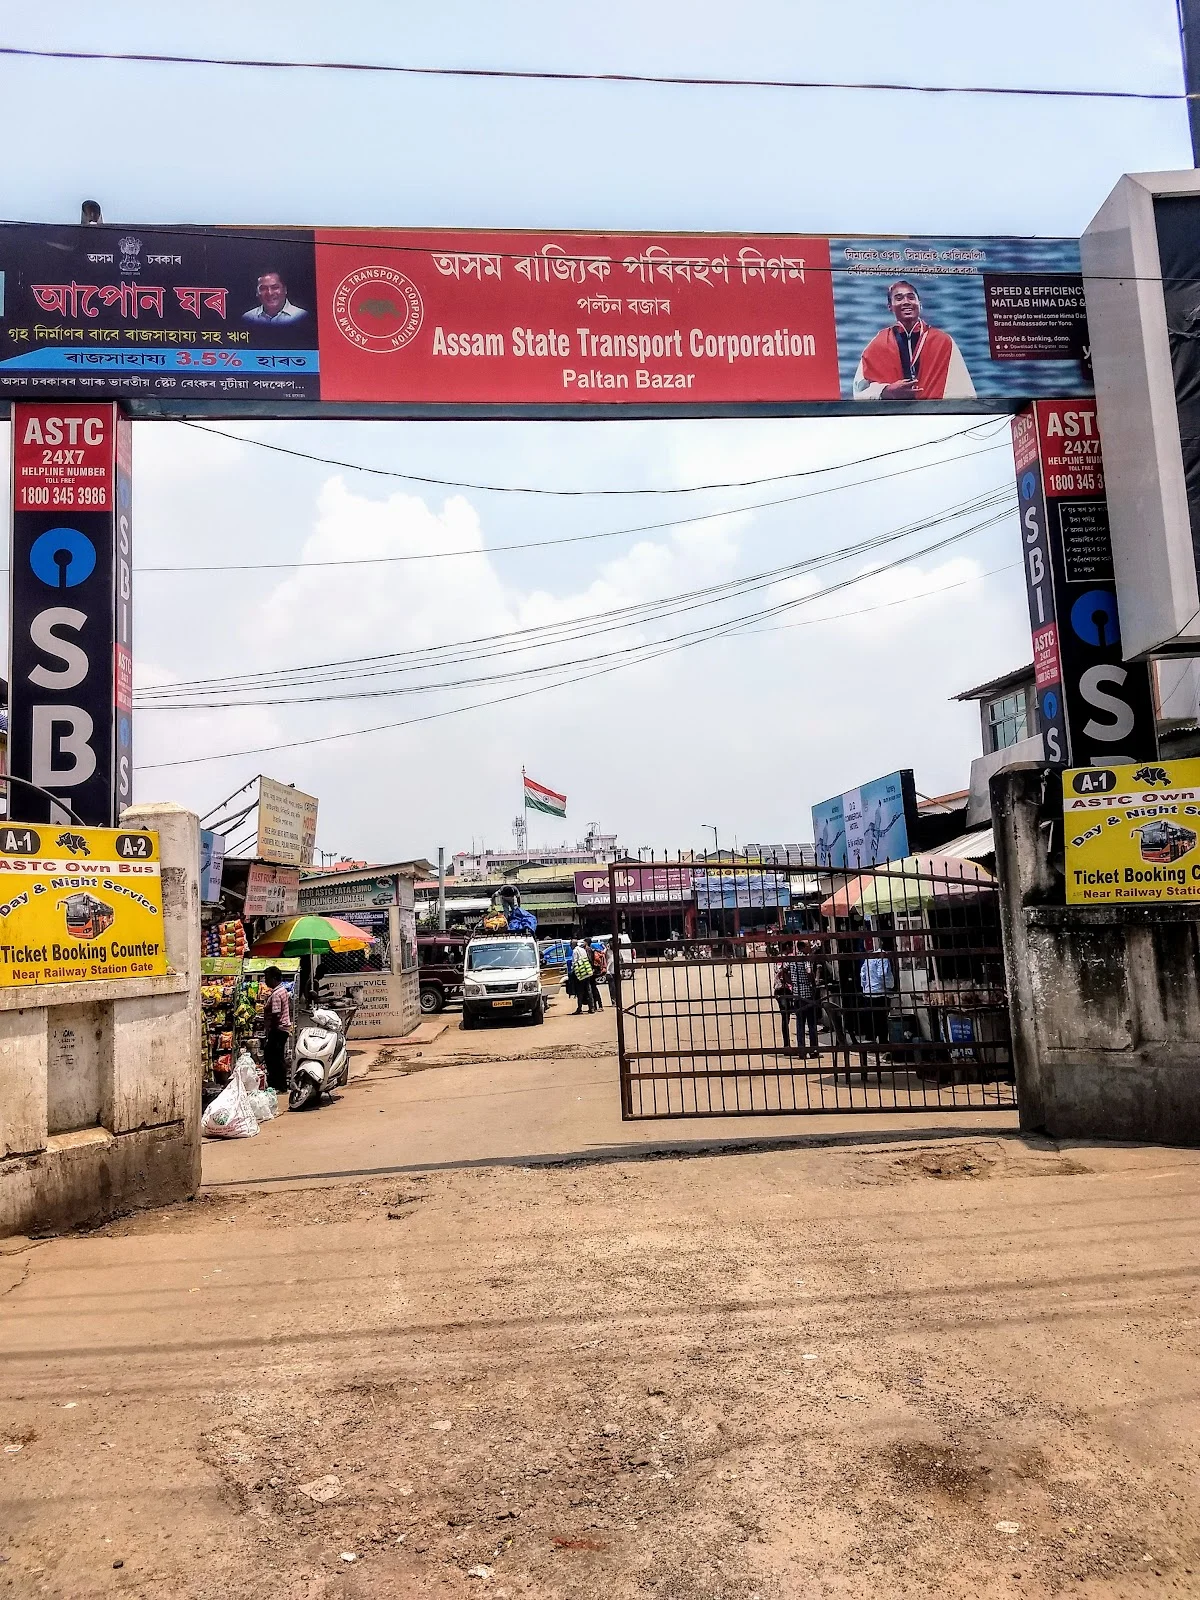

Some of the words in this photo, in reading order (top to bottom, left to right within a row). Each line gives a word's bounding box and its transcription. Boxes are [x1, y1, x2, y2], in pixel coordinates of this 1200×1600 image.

[87, 253, 114, 264] অসম
[146, 254, 182, 266] চৰকাৰ
[432, 252, 503, 282] অসম
[622, 244, 729, 288] পৰিবহণ
[737, 246, 806, 284] নিগম
[348, 270, 406, 286] TRANSPORT
[31, 280, 166, 319] আপোন
[173, 286, 229, 320] ঘৰ
[337, 285, 351, 313] STATE
[990, 287, 1022, 296] SPEED
[1024, 287, 1031, 296] &
[577, 292, 622, 316] পল্টন
[628, 297, 671, 316] বজাৰ
[992, 299, 1030, 307] MATLAB
[1032, 298, 1057, 307] HIMA
[1058, 298, 1078, 307] DAS
[1079, 298, 1086, 307] &
[392, 286, 420, 346] CORPORATION
[8, 328, 30, 343] গৃহ
[88, 328, 120, 341] বাবে
[202, 331, 223, 345] সহ
[227, 331, 250, 344] ঋণ
[340, 317, 368, 345] ASSAM
[433, 326, 504, 357] Assam
[512, 327, 570, 357] State
[577, 328, 683, 364] Transport
[690, 328, 816, 364] Corporation
[176, 352, 242, 367] 3.5%
[256, 355, 307, 368] হাৰত
[1, 377, 28, 386] অসম
[564, 370, 628, 389] Paltan
[636, 370, 695, 389] Bazar
[23, 417, 104, 446] ASTC
[1064, 440, 1100, 455] 24X7
[42, 450, 85, 465] 24X7
[1048, 456, 1084, 465] HELPLINE
[22, 467, 64, 476] HELPLINE
[67, 468, 106, 477] NUMBER
[1050, 474, 1074, 490] 1800
[1076, 474, 1095, 490] 345
[21, 486, 49, 505] 1800
[53, 487, 74, 505] 345
[78, 487, 106, 505] 3986
[1024, 506, 1045, 623] SBI
[1034, 630, 1054, 652] ASTC
[1081, 772, 1107, 792] A-1
[1072, 796, 1133, 809] ASTC
[1142, 792, 1195, 803] Own
[1072, 824, 1102, 847] Day
[1107, 816, 1121, 826] &
[1126, 806, 1179, 819] Night
[6, 830, 32, 852] A-1
[123, 838, 147, 856] A-2
[0, 860, 57, 872] ASTC
[66, 862, 111, 873] Own
[118, 864, 154, 873] Bus
[1074, 868, 1120, 885] Ticket
[1124, 866, 1186, 885] Booking
[0, 892, 29, 917] Day
[33, 884, 47, 895] &
[51, 876, 98, 889] Night
[102, 880, 158, 915] Service
[316, 888, 333, 898] ASTC
[334, 886, 351, 895] TATA
[352, 884, 372, 893] SUMO
[1084, 890, 1112, 899] Near
[1116, 888, 1162, 898] Railway
[301, 897, 332, 907] BOOKING
[334, 894, 365, 904] COUNTER
[1, 944, 48, 964] Ticket
[52, 943, 107, 963] Booking
[111, 941, 159, 958] Counter
[12, 970, 41, 980] Near
[44, 967, 87, 977] Railway
[91, 964, 128, 975] Station
[130, 962, 154, 972] Gate
